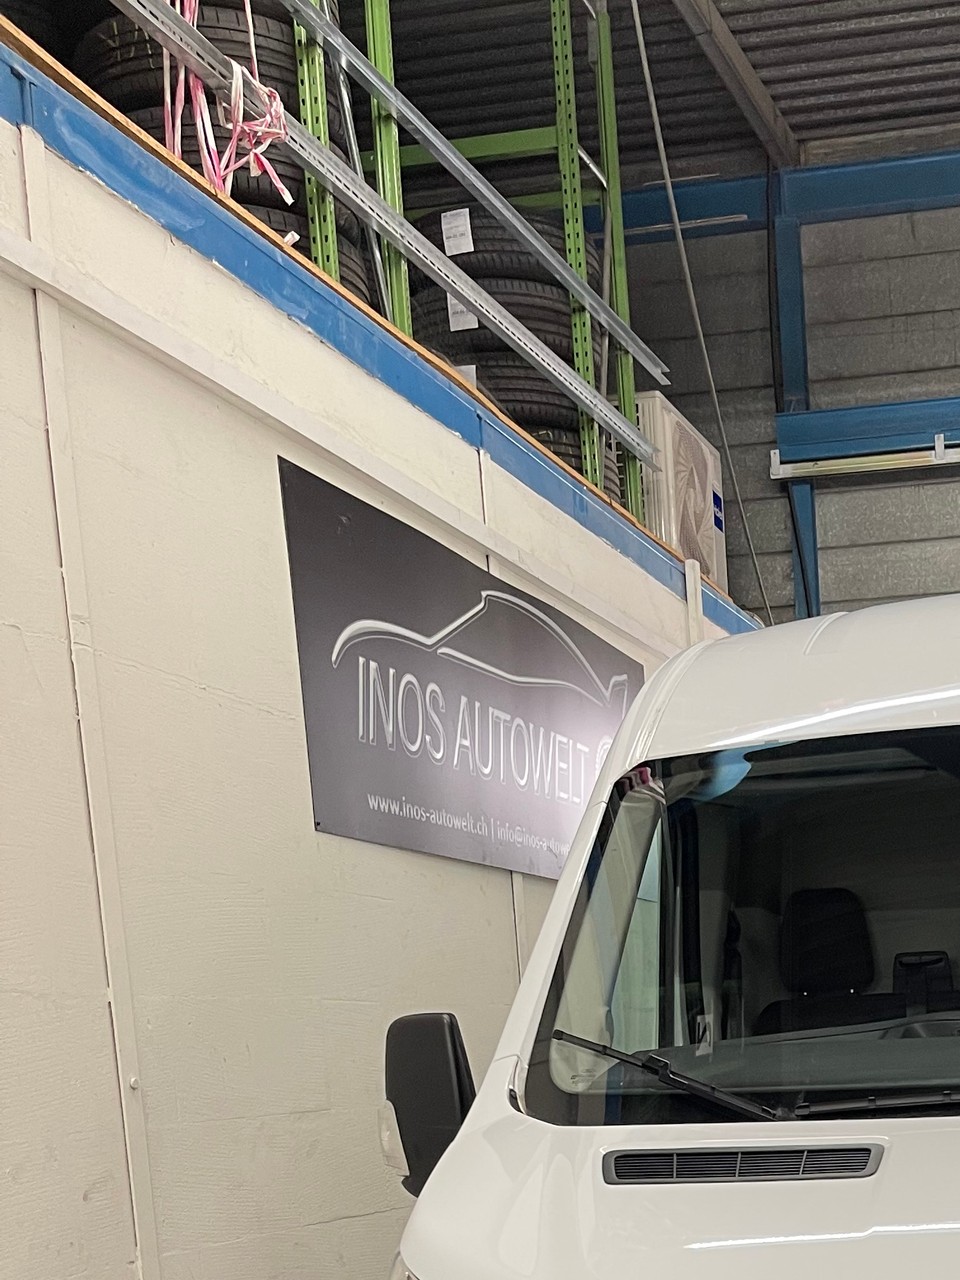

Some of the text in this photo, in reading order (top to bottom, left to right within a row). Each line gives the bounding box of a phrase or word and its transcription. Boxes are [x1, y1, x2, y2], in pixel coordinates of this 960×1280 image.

[358, 656, 447, 765] INOS
[453, 695, 589, 807] AUTOWELT
[367, 793, 488, 837] www.inos-autowelt.ch
